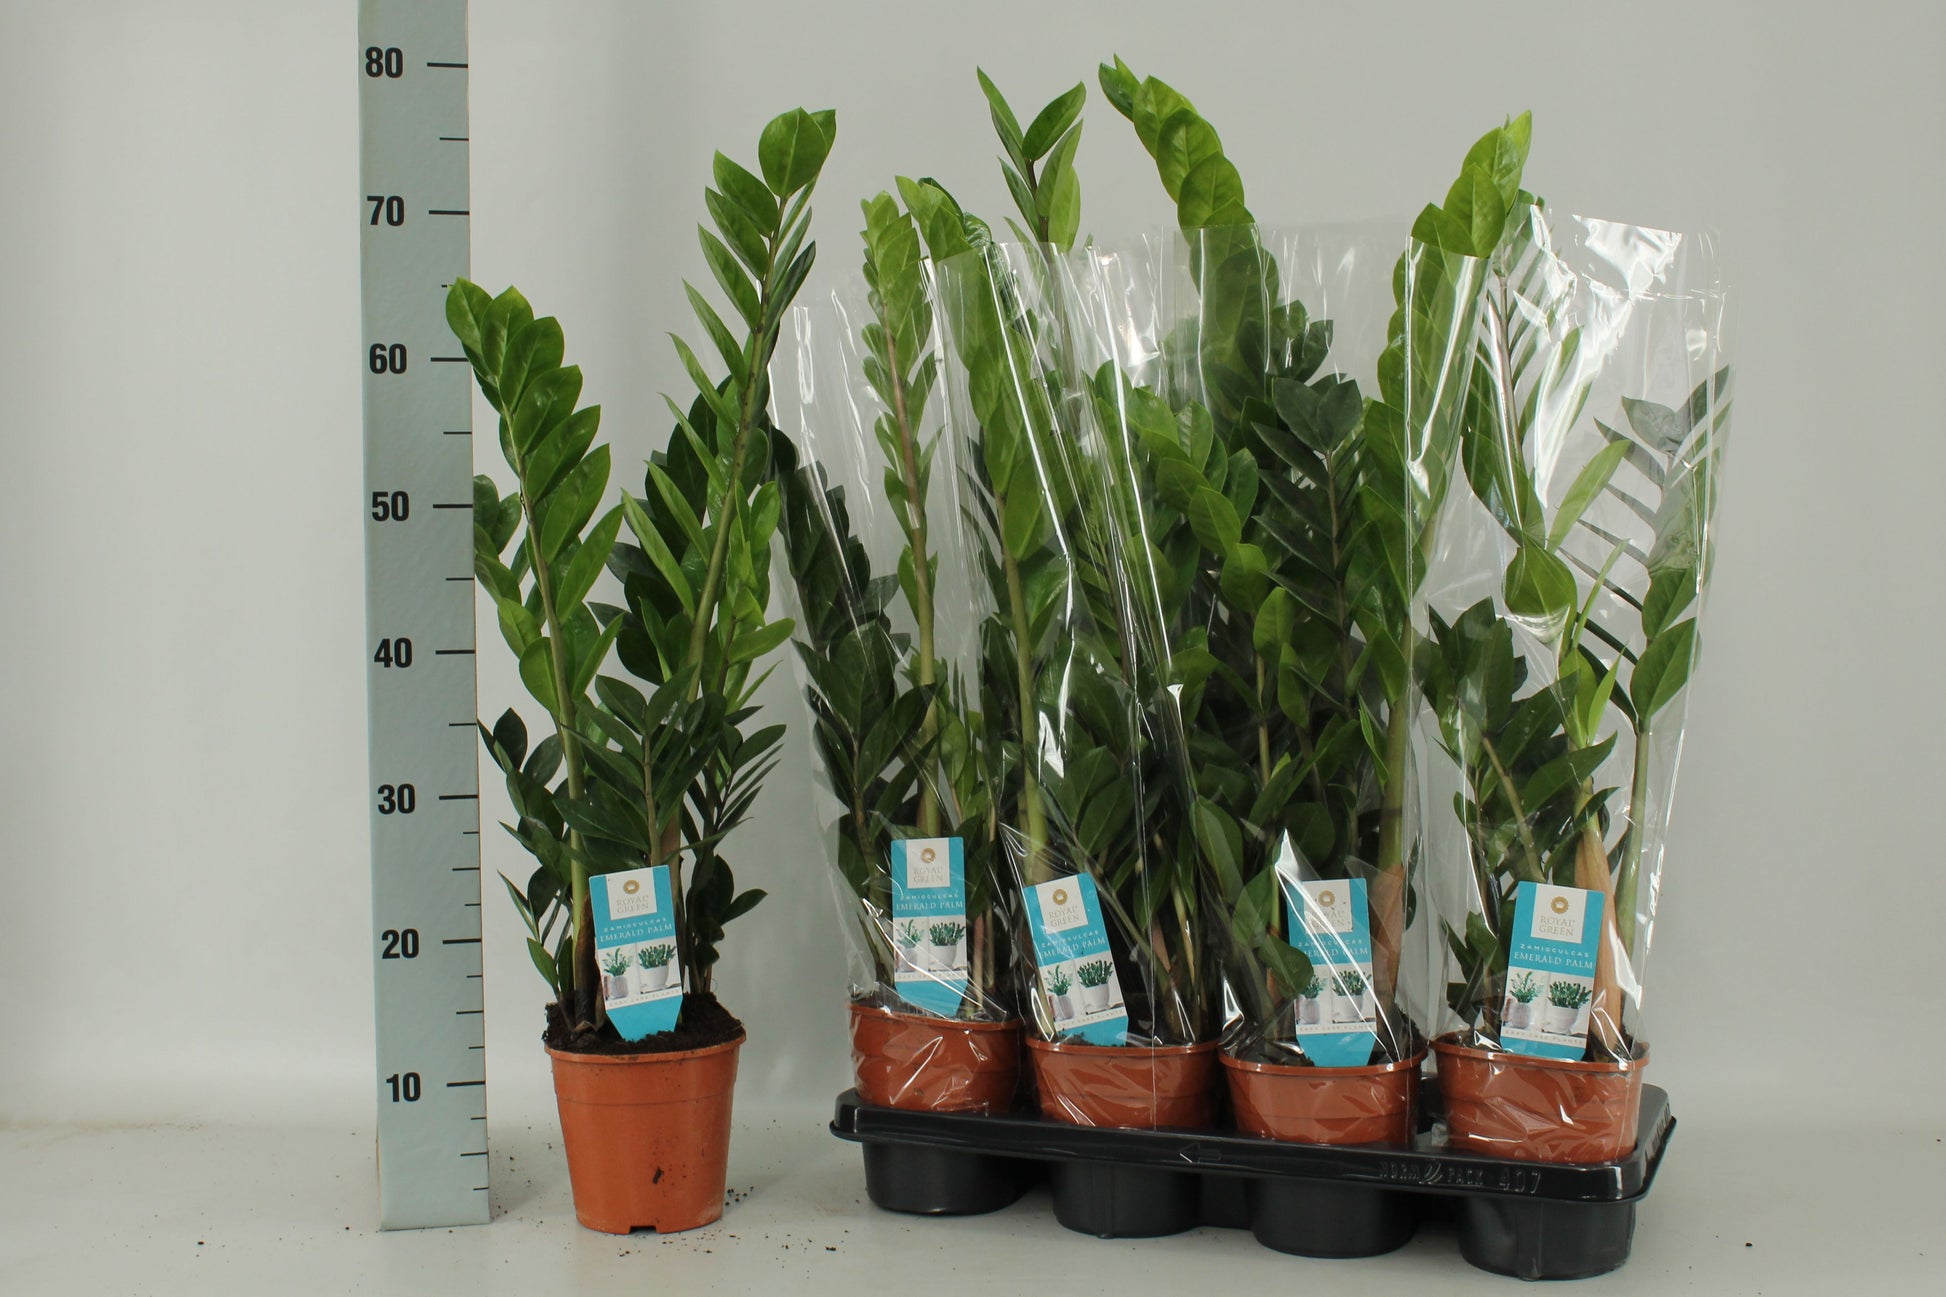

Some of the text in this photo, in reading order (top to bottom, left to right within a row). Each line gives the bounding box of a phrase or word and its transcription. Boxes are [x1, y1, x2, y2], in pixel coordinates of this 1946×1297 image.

[366, 47, 403, 78] 80
[367, 196, 404, 226] 70
[370, 344, 407, 374] 60
[372, 491, 409, 521] 50
[374, 638, 412, 668] 40
[378, 784, 415, 814] 30
[896, 901, 963, 911] EMERALD PALM
[1540, 915, 1573, 927] ROYAL
[382, 929, 419, 959] 20
[600, 923, 673, 943] EMERALD PALM
[1082, 937, 1106, 949] PALM
[1539, 925, 1574, 936] GREEN
[1514, 952, 1593, 969] EMERALD PALM
[1520, 943, 1589, 958] ZAMIOCULCAS
[386, 1072, 420, 1102] 10
